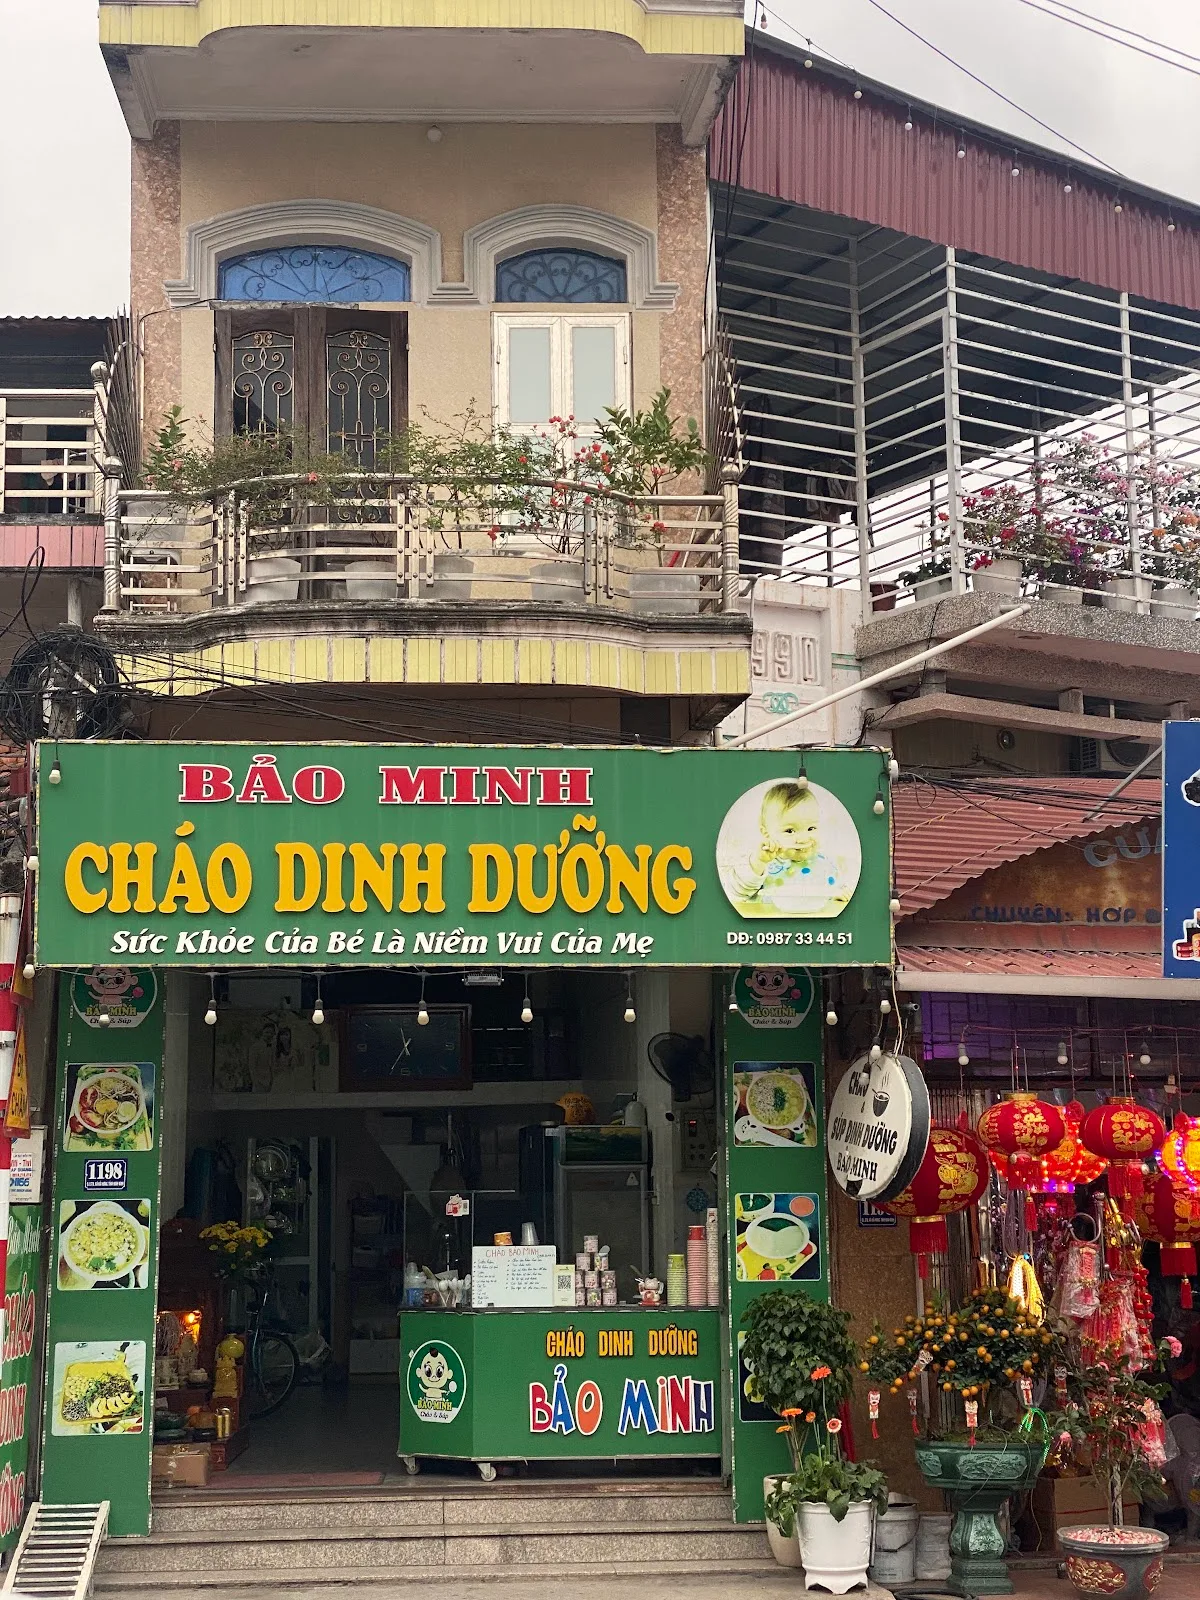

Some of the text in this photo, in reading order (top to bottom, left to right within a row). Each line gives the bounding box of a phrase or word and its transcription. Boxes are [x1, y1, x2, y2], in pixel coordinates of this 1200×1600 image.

[178, 754, 594, 805] BẢO MINH
[64, 813, 697, 914] CHÁO DINH DƯỠNG
[109, 926, 655, 958] Sức Khỏe Của Bé Là Niềm Vui Của Mẹ
[726, 932, 853, 945] DĐ: 0987 33 44 51
[845, 1119, 864, 1147] DINH
[862, 1120, 898, 1156] DƯỠNG
[88, 1162, 123, 1180] 1198
[546, 1323, 698, 1357] CHÁO DINH DƯỠNG
[529, 1363, 603, 1436] BẢO
